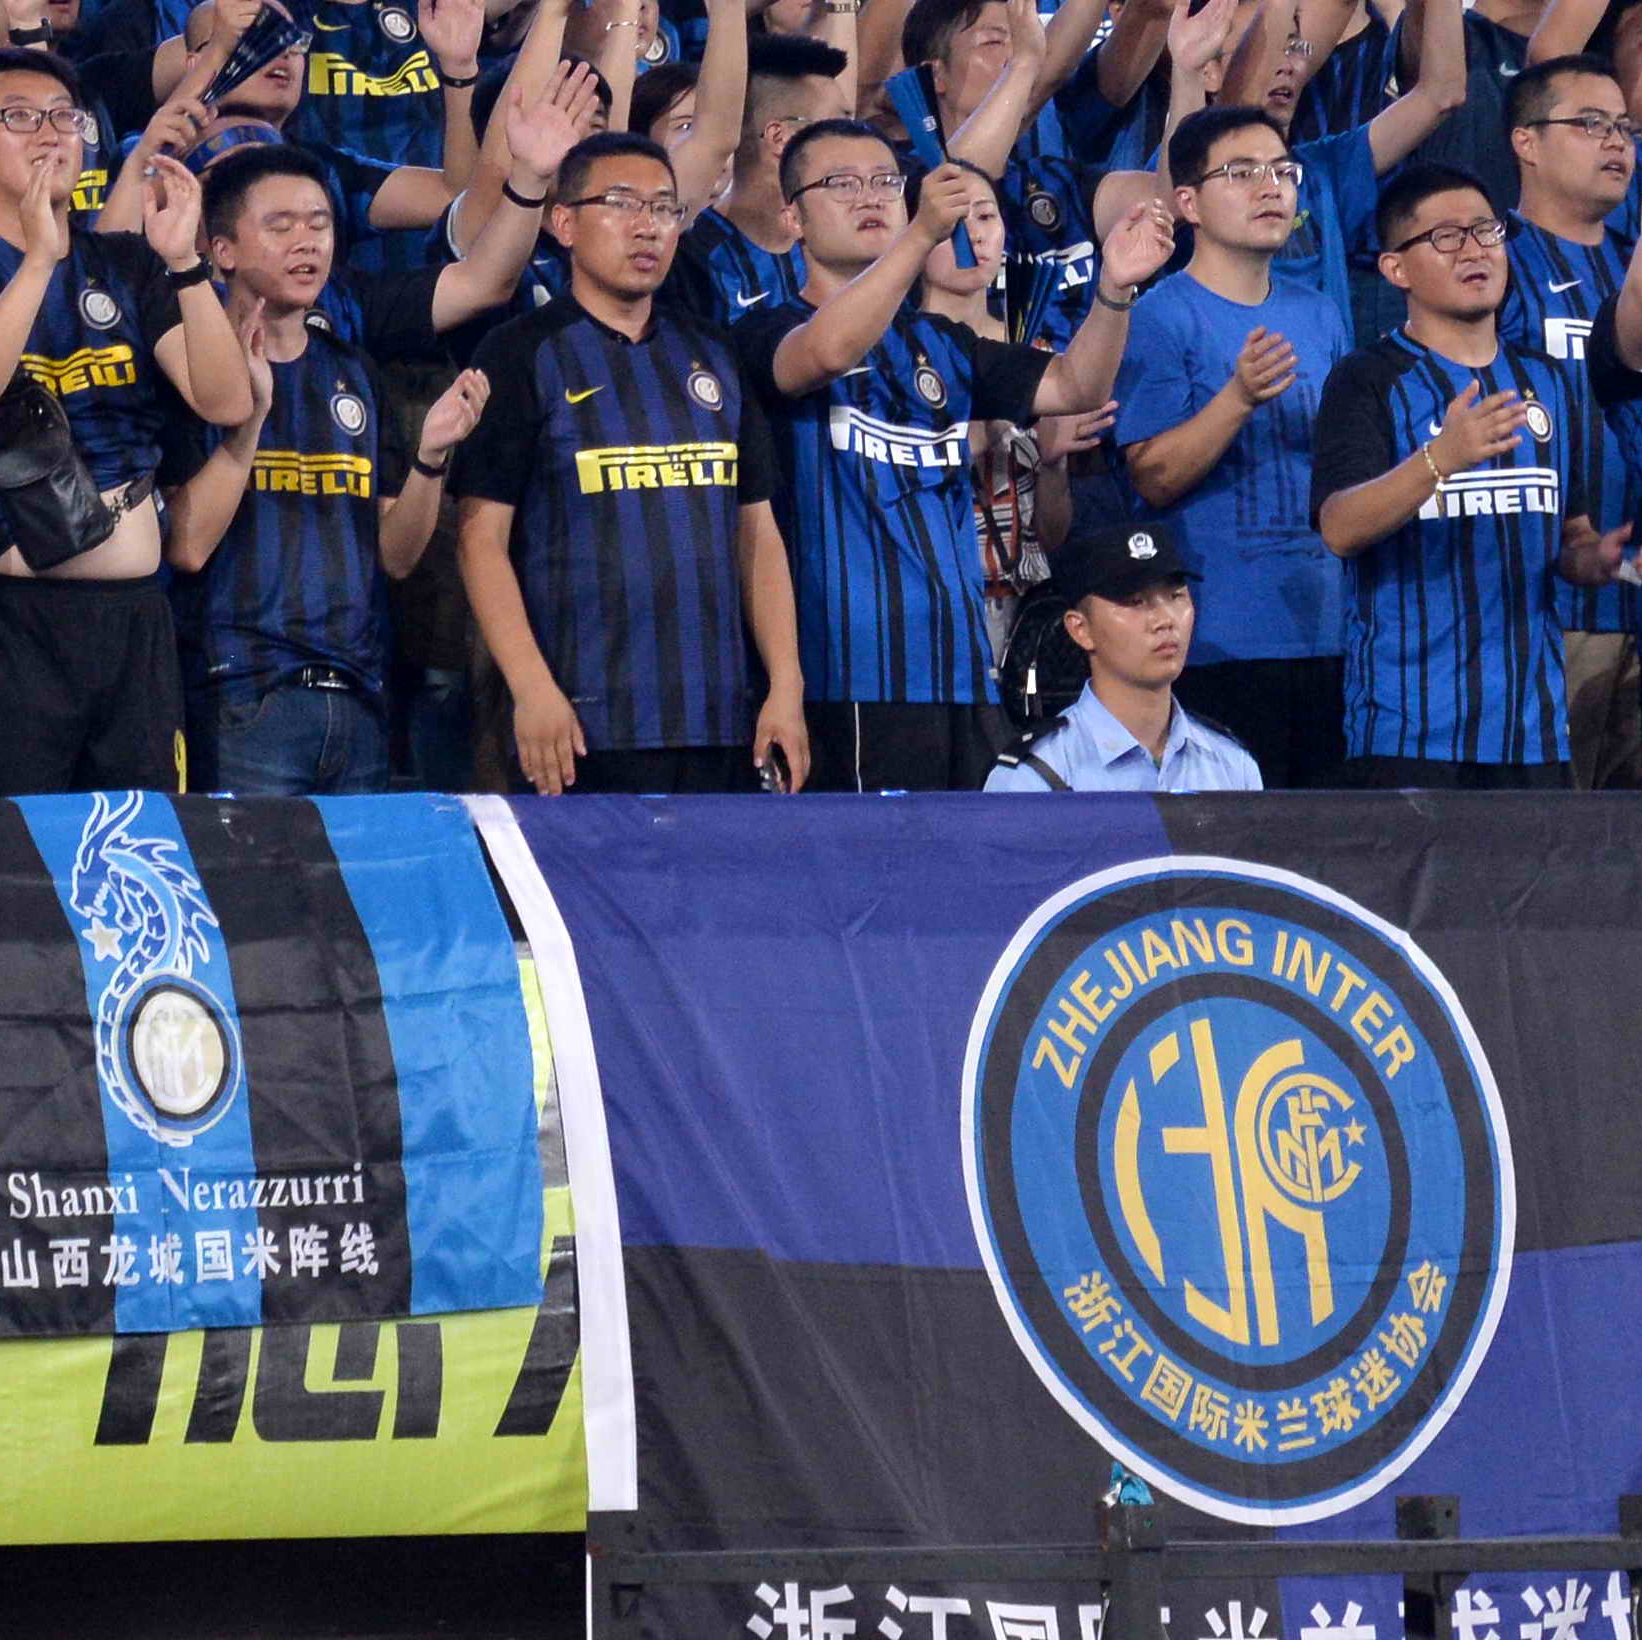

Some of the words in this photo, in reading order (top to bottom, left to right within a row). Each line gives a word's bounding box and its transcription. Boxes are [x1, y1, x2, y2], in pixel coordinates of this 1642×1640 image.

[307, 50, 440, 98] PIRELLI
[829, 405, 970, 469] PIRELLI
[249, 450, 373, 499] IRELLI
[575, 442, 738, 495] PIRELLI
[1031, 918, 1255, 1090] ZHEJIANG
[1271, 929, 1417, 1080] INTER
[6, 1171, 139, 1220] Shanxi
[157, 1161, 365, 1214] Nerazzurri
[1, 1222, 381, 1291] 山西龙城国米阵线
[1062, 1258, 1449, 1455] 浙江国际米兰球迷协会
